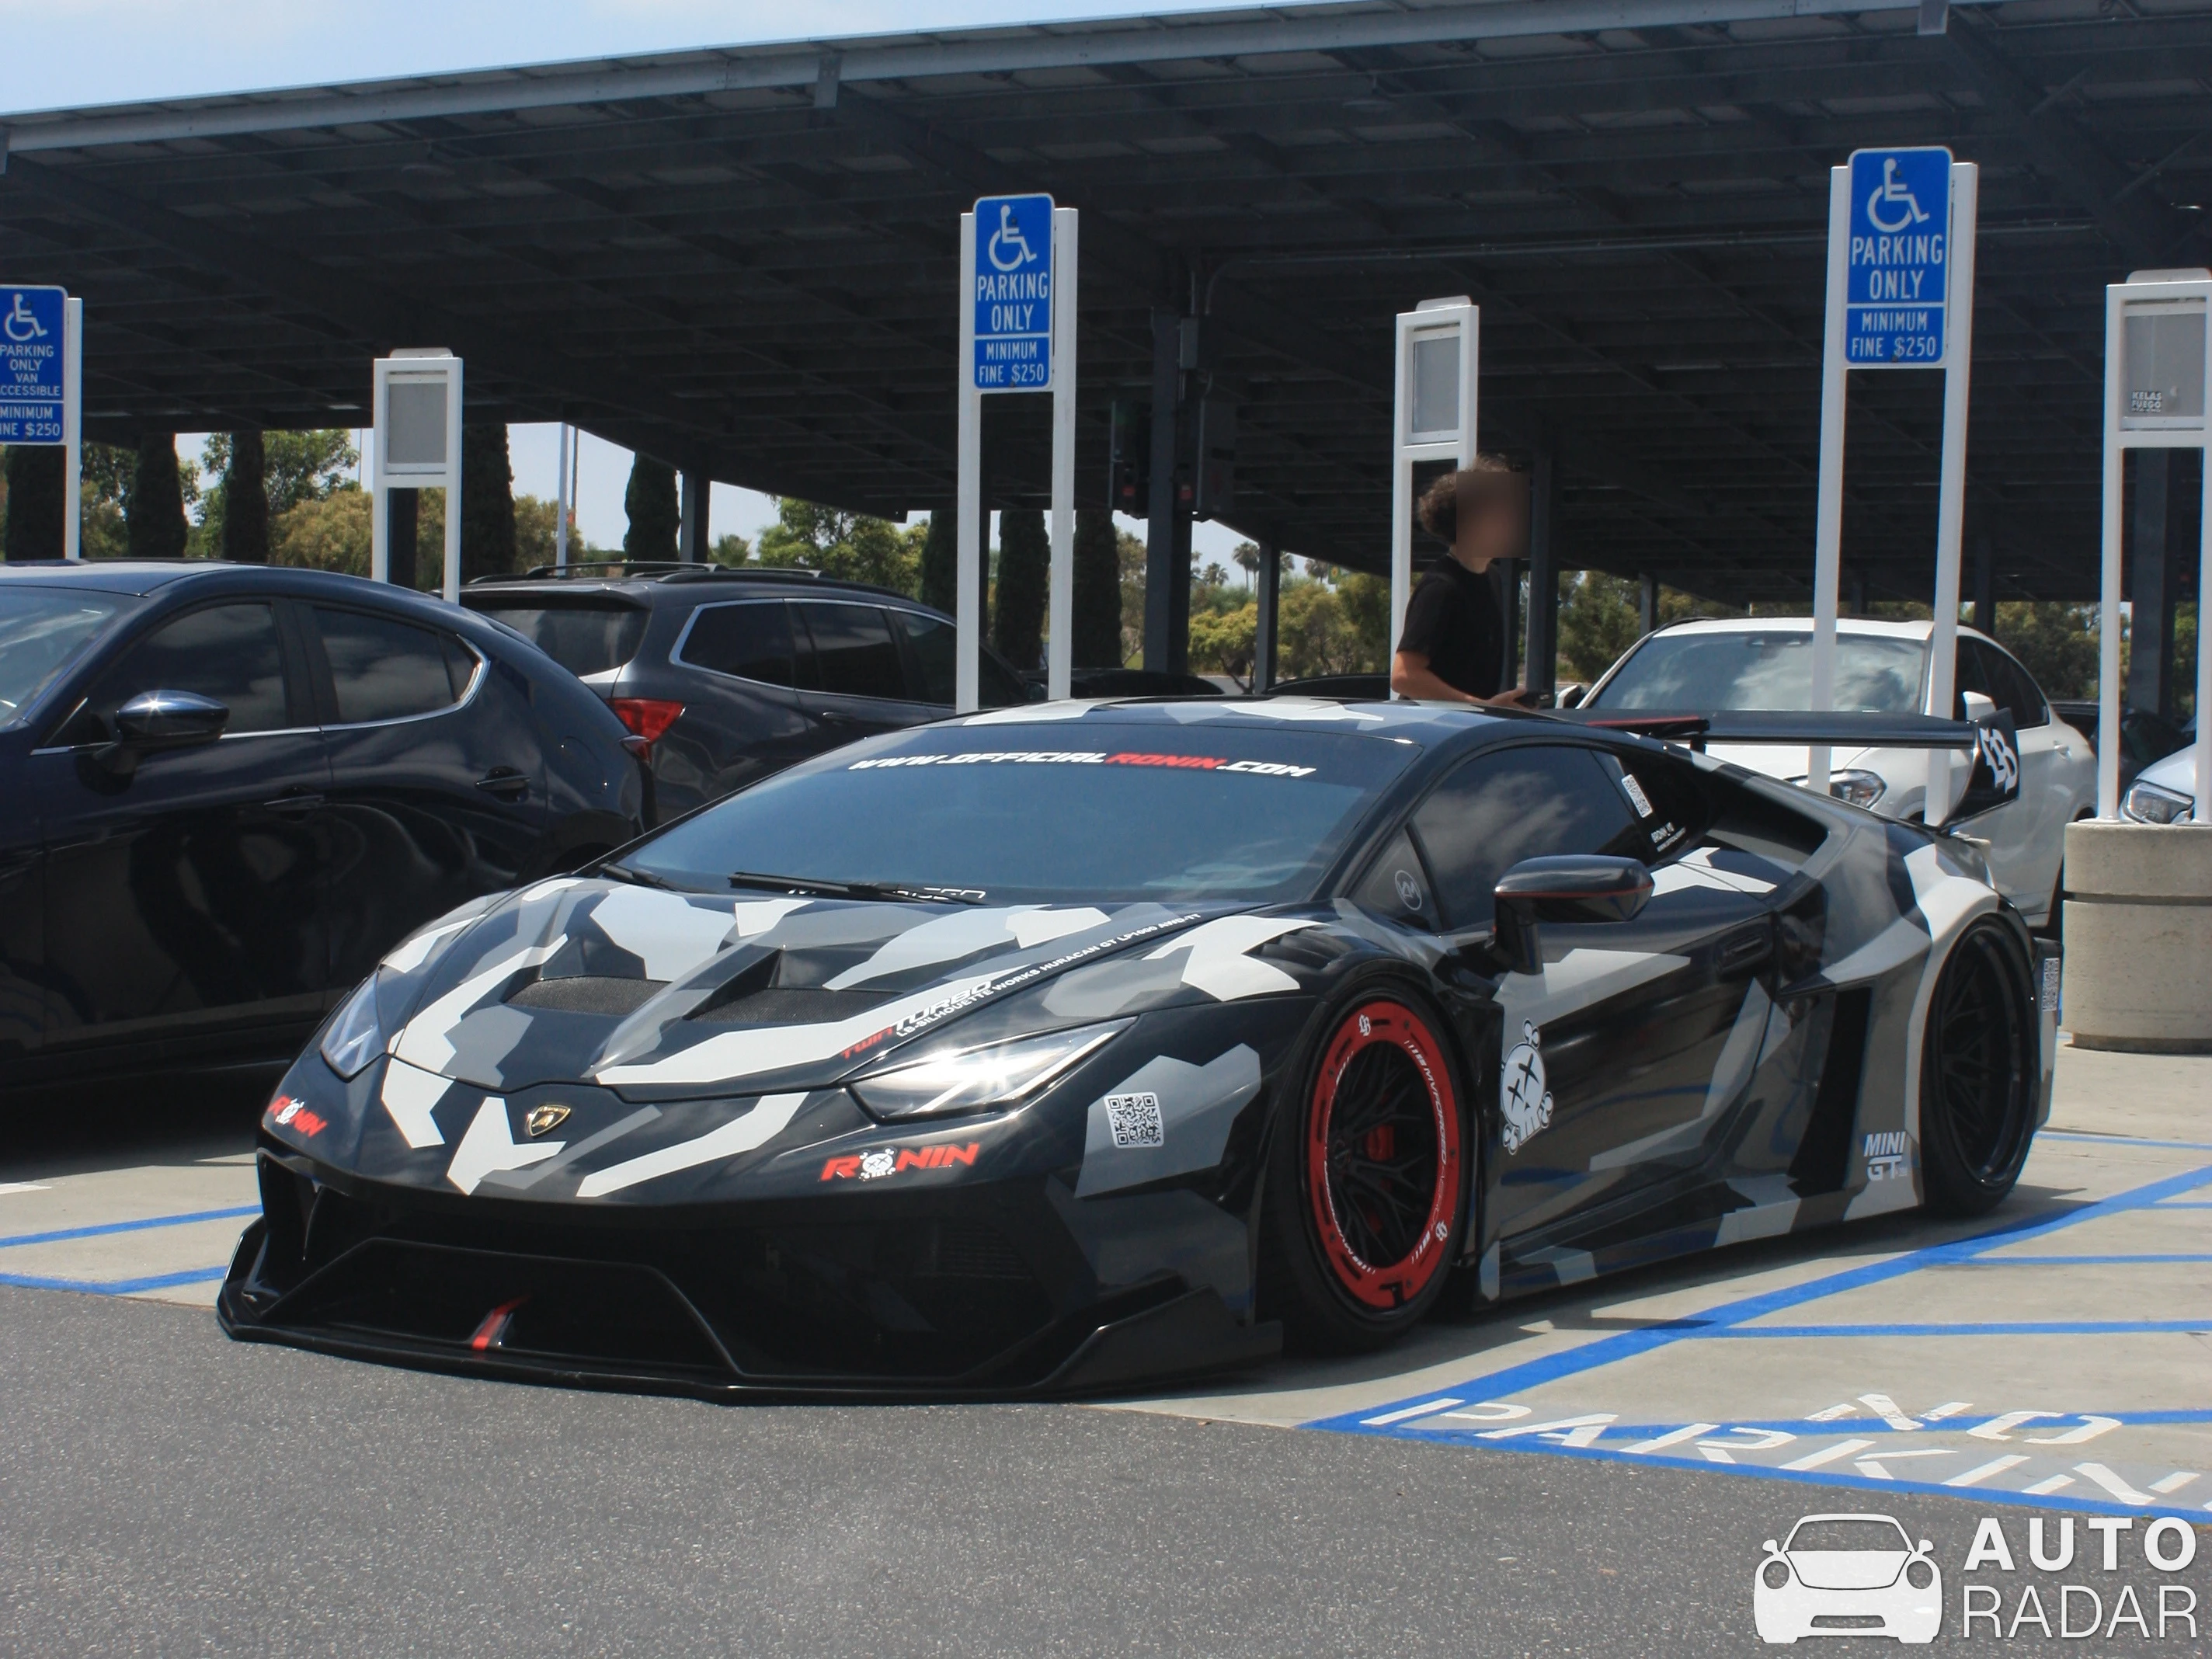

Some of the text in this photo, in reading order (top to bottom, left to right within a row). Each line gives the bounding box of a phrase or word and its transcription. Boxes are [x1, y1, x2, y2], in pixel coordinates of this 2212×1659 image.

[1851, 235, 1943, 266] PARKING
[977, 272, 1048, 301] PARKING
[1869, 270, 1924, 300] ONLY
[991, 304, 1034, 332] ONLY
[1861, 311, 1929, 332] MINIMUM
[0, 344, 54, 357] PARKING
[986, 341, 1038, 360] MINIMUM
[1852, 336, 1936, 358] FINE $250
[9, 358, 43, 371] ONLY
[979, 363, 1045, 384] FINE $250
[0, 385, 61, 396] CCESSIBLE
[16, 373, 38, 384] VAN
[0, 406, 53, 419] MINIMUM
[0, 422, 61, 437] INE $250
[992, 969, 1041, 992] WORKS
[1038, 945, 1101, 972] HURACAN
[1099, 938, 1118, 949] GT
[893, 980, 993, 1031] TURBO
[1863, 1131, 1907, 1157] MINI
[1866, 1155, 1903, 1181] GT
[1803, 1393, 2123, 1445] NO
[1359, 1397, 2212, 1511] PARKIN
